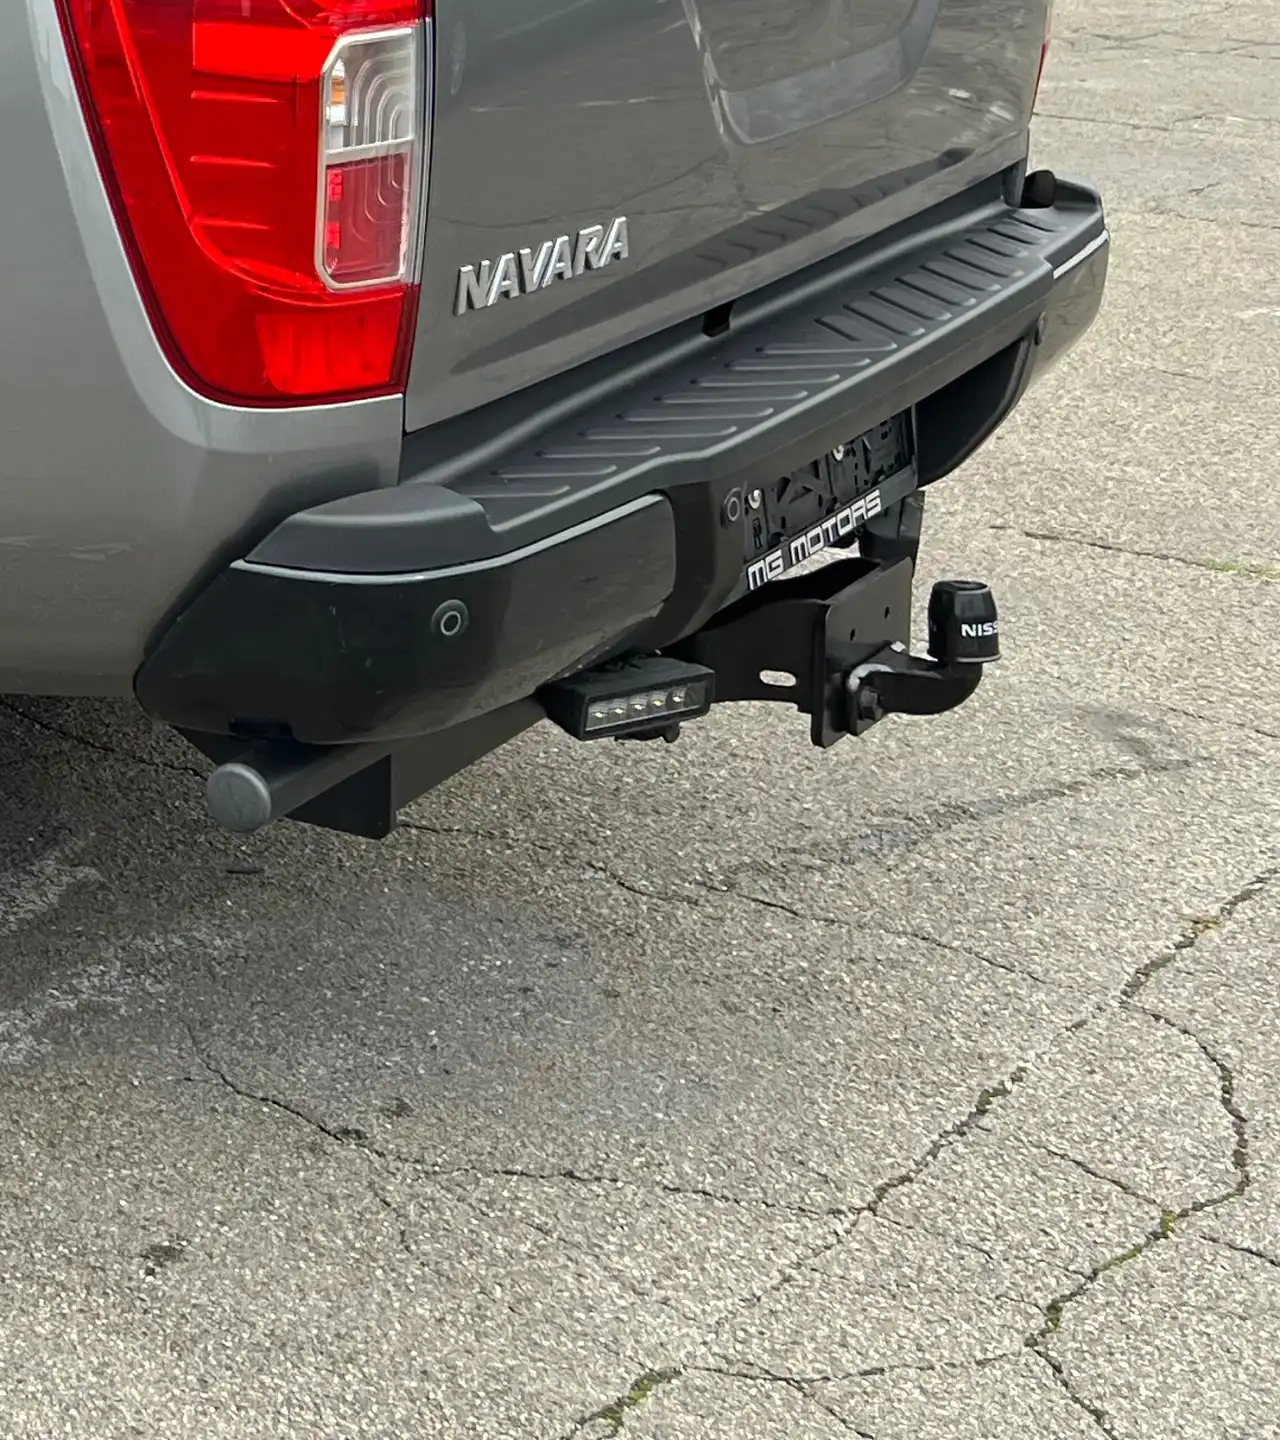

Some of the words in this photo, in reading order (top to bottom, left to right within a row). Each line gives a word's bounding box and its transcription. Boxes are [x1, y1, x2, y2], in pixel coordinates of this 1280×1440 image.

[453, 215, 631, 317] NAVARA
[747, 549, 785, 591] MG
[789, 488, 882, 565] MOTORS
